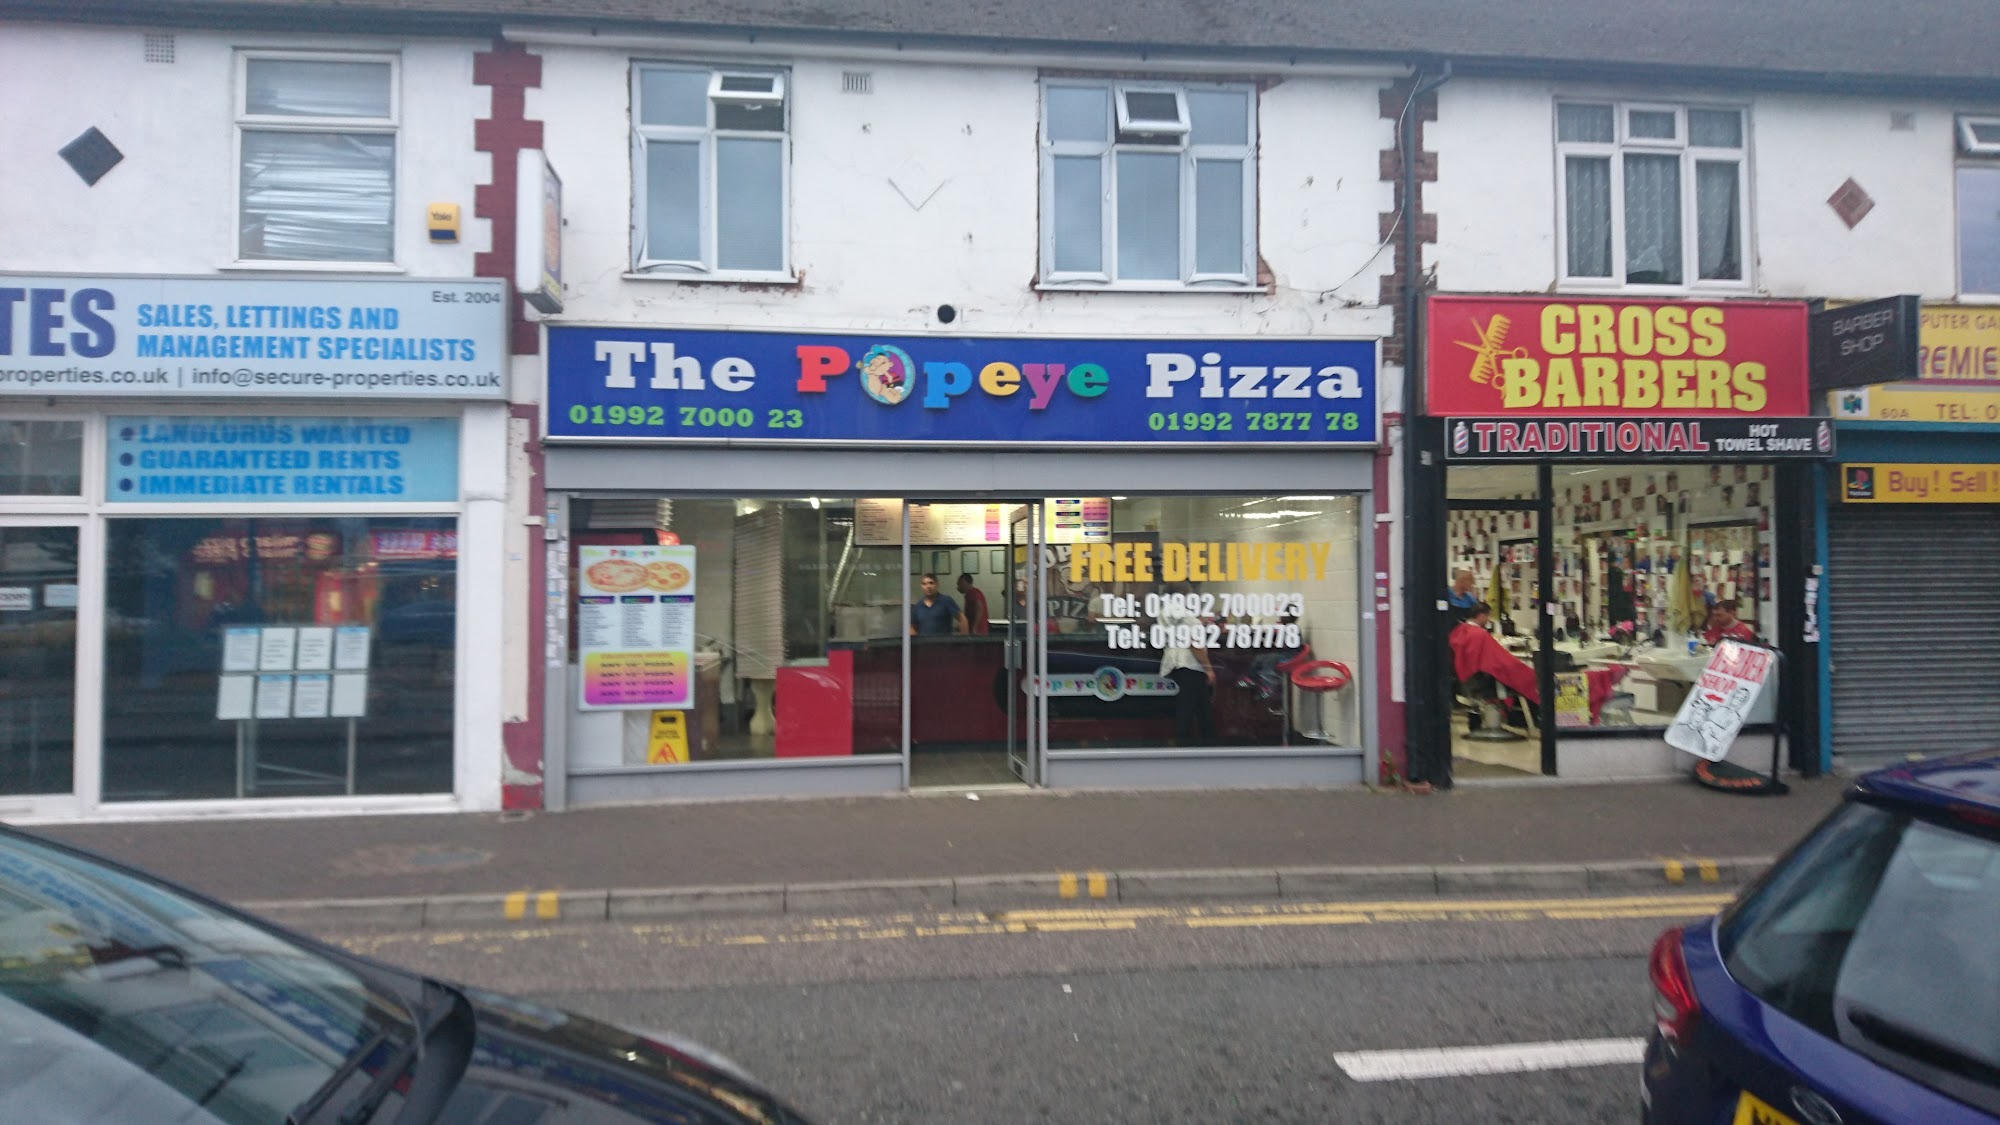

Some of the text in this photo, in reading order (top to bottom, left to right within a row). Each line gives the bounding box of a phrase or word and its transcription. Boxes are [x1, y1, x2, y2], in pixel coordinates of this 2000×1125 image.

[432, 290, 501, 304] Est. 2004
[137, 304, 399, 330] SALES, LETTINGS AND
[1833, 309, 1893, 336] BARBER
[1975, 314, 2000, 330] GA
[1540, 304, 1727, 357] CROSS
[137, 334, 476, 361] MANAGEMENT SPECIALISTS
[1841, 333, 1885, 356] SHOP
[193, 368, 500, 388] info@secure-properties.co.uk
[595, 340, 756, 392] The
[1146, 352, 1363, 399] Pizza
[1501, 357, 1768, 412] BARBERS
[570, 404, 803, 429] 01992 7000 23
[1148, 412, 1359, 432] 01992 7877 78
[301, 425, 411, 445] WANTED
[1472, 421, 1710, 453] TRADITIONAL
[1748, 423, 1779, 438] HOT
[1715, 437, 1813, 452] TOWEL SHAVE
[139, 449, 400, 470] GUARANTEED RENTS
[139, 475, 406, 495] IMMEDIATE RENTALS
[1070, 542, 1154, 583] FREE
[1162, 542, 1331, 583] DELIVERY
[1100, 593, 1304, 618] Tel: 01992 700023
[1105, 624, 1301, 649] Tel: 01992 787778
